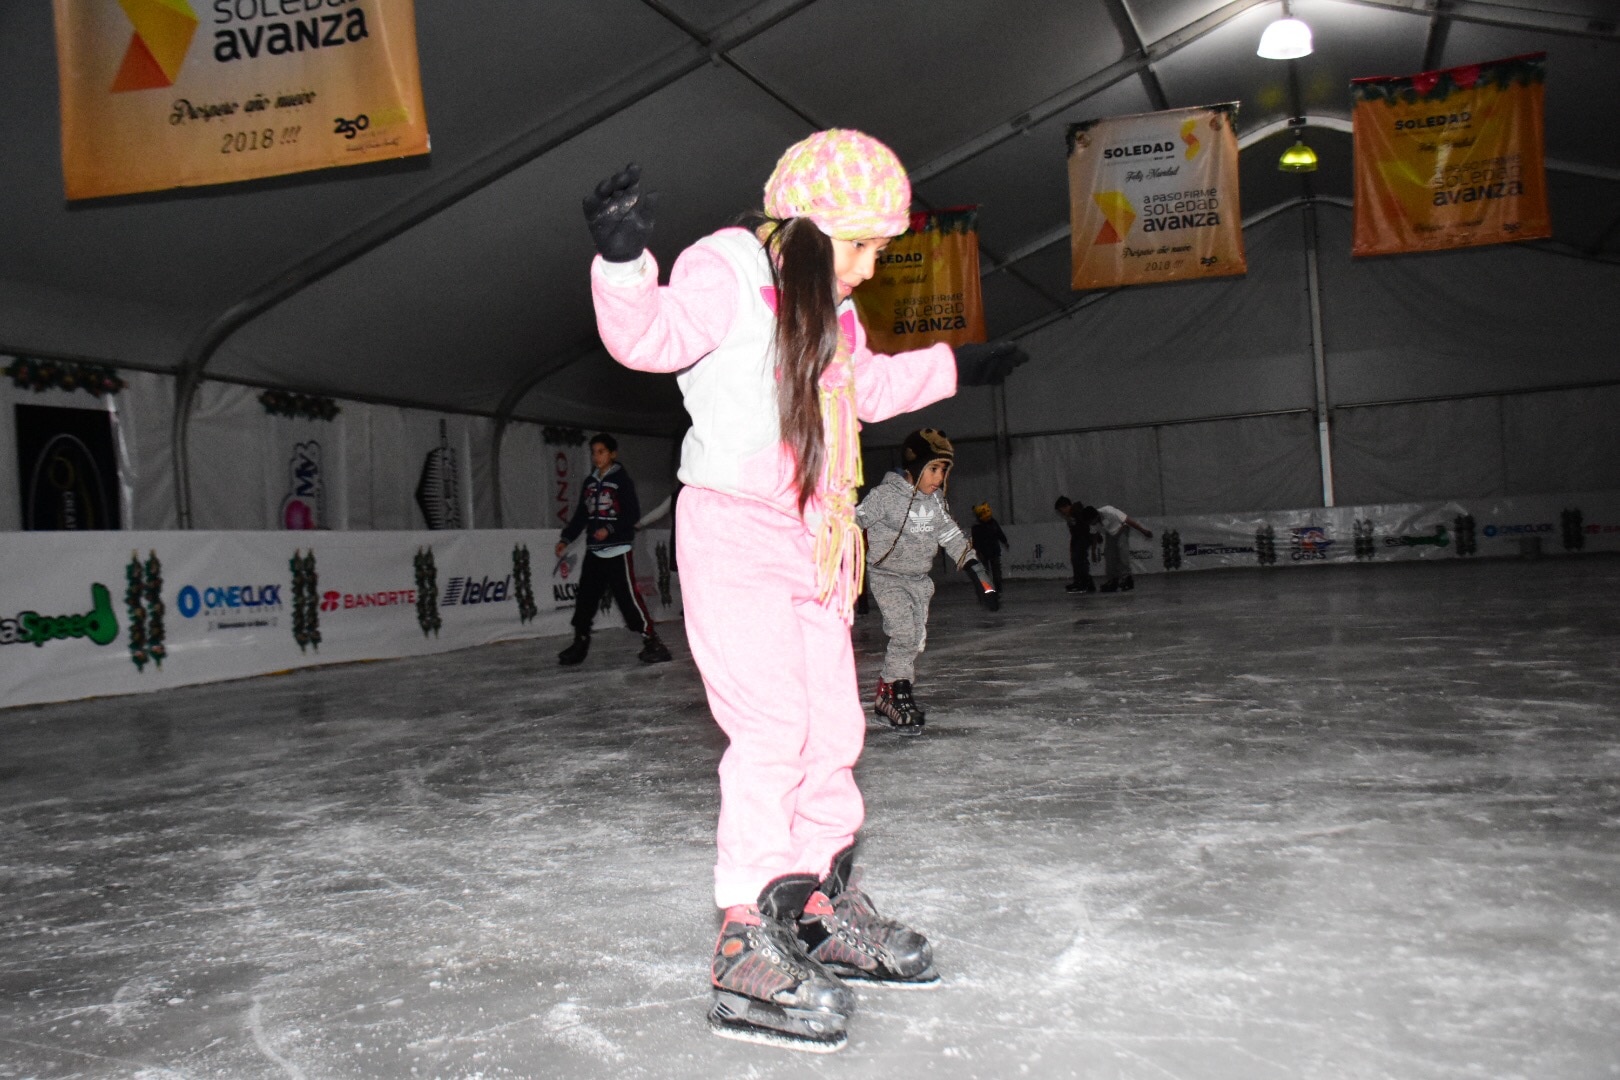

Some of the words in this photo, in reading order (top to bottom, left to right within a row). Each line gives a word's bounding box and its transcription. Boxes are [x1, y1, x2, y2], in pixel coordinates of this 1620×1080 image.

[213, 0, 360, 24] SOLe
[334, 114, 369, 139] 250
[1394, 111, 1472, 130] SOLEDAD
[221, 128, 274, 154] 2018
[1104, 141, 1175, 159] SOLEDAD
[878, 252, 923, 265] LEDAD
[1144, 260, 1171, 272] 2018
[909, 524, 934, 533] adidas
[204, 584, 282, 608] ONECLICK
[344, 589, 416, 610] BANORTE
[462, 574, 510, 605] telcel
